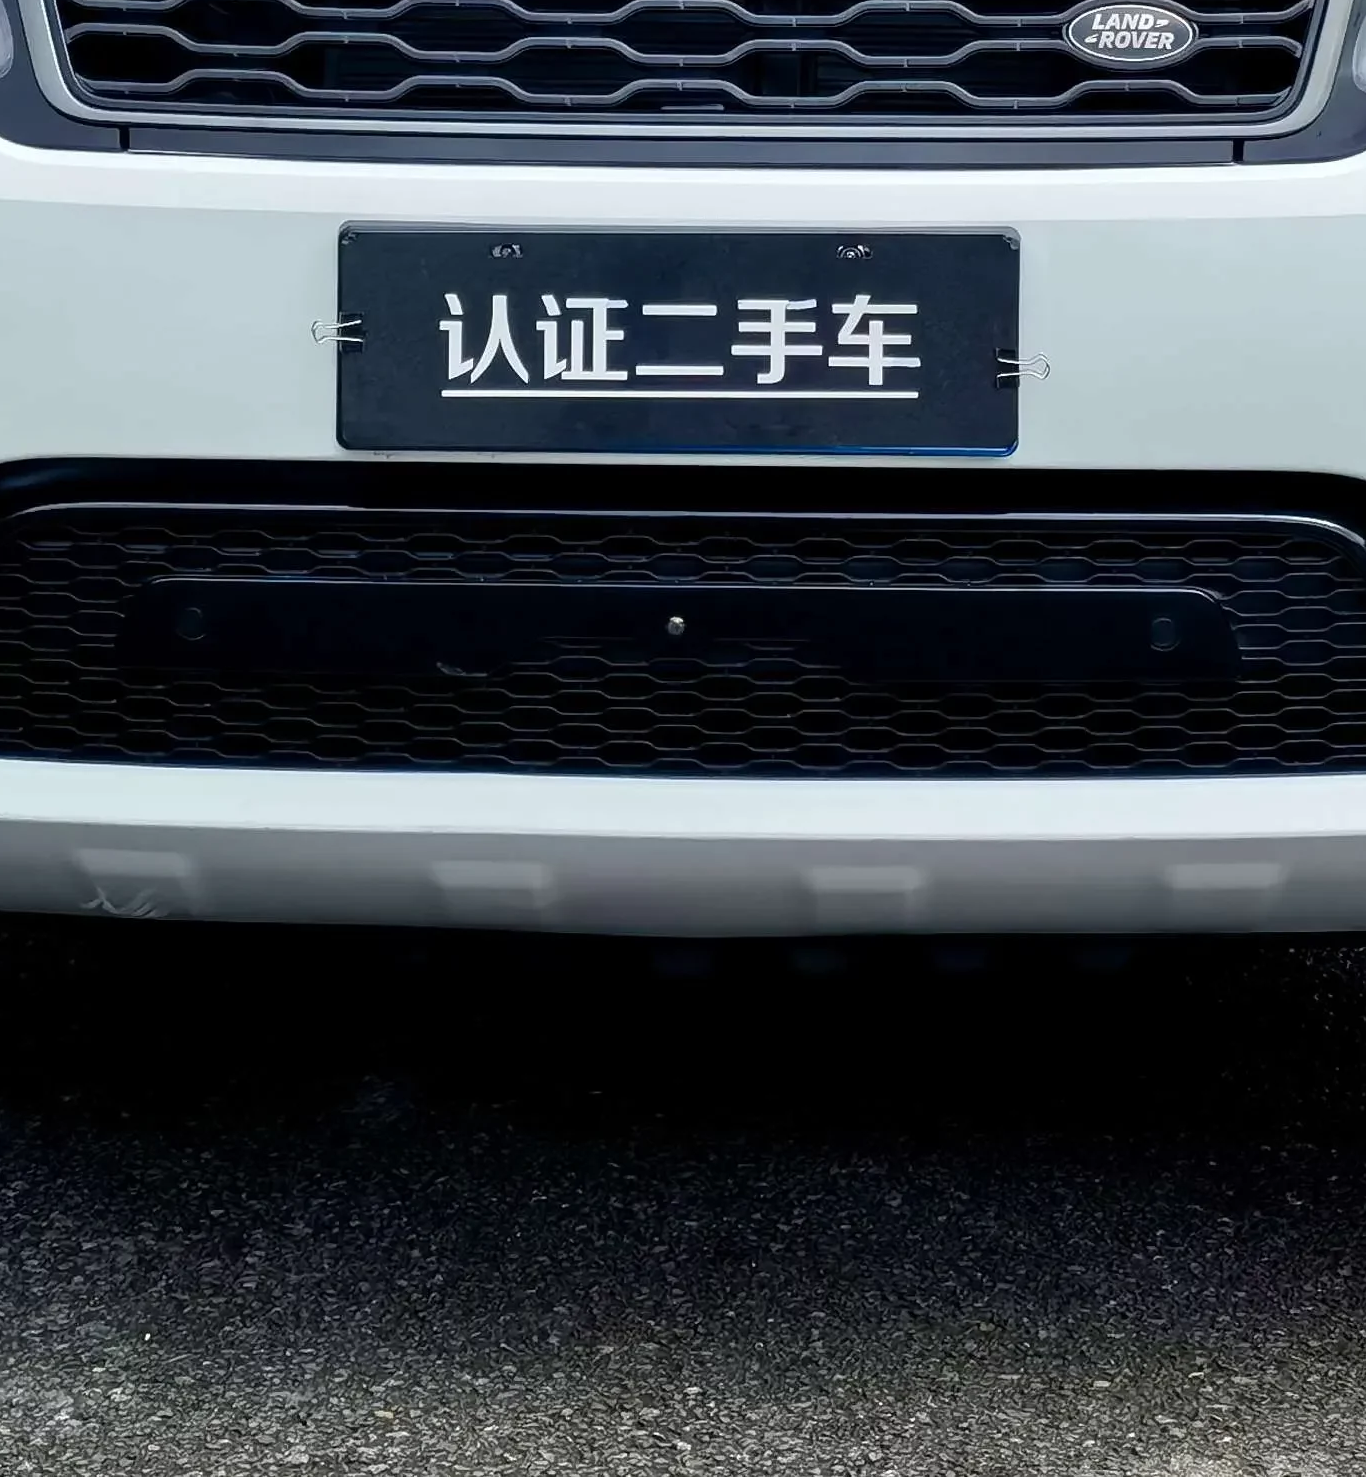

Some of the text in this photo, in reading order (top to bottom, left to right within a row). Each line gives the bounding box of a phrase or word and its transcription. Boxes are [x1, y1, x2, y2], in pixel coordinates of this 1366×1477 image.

[1091, 13, 1155, 30] LAND
[1098, 31, 1175, 50] ROVER
[439, 294, 921, 386] 认证二手车
